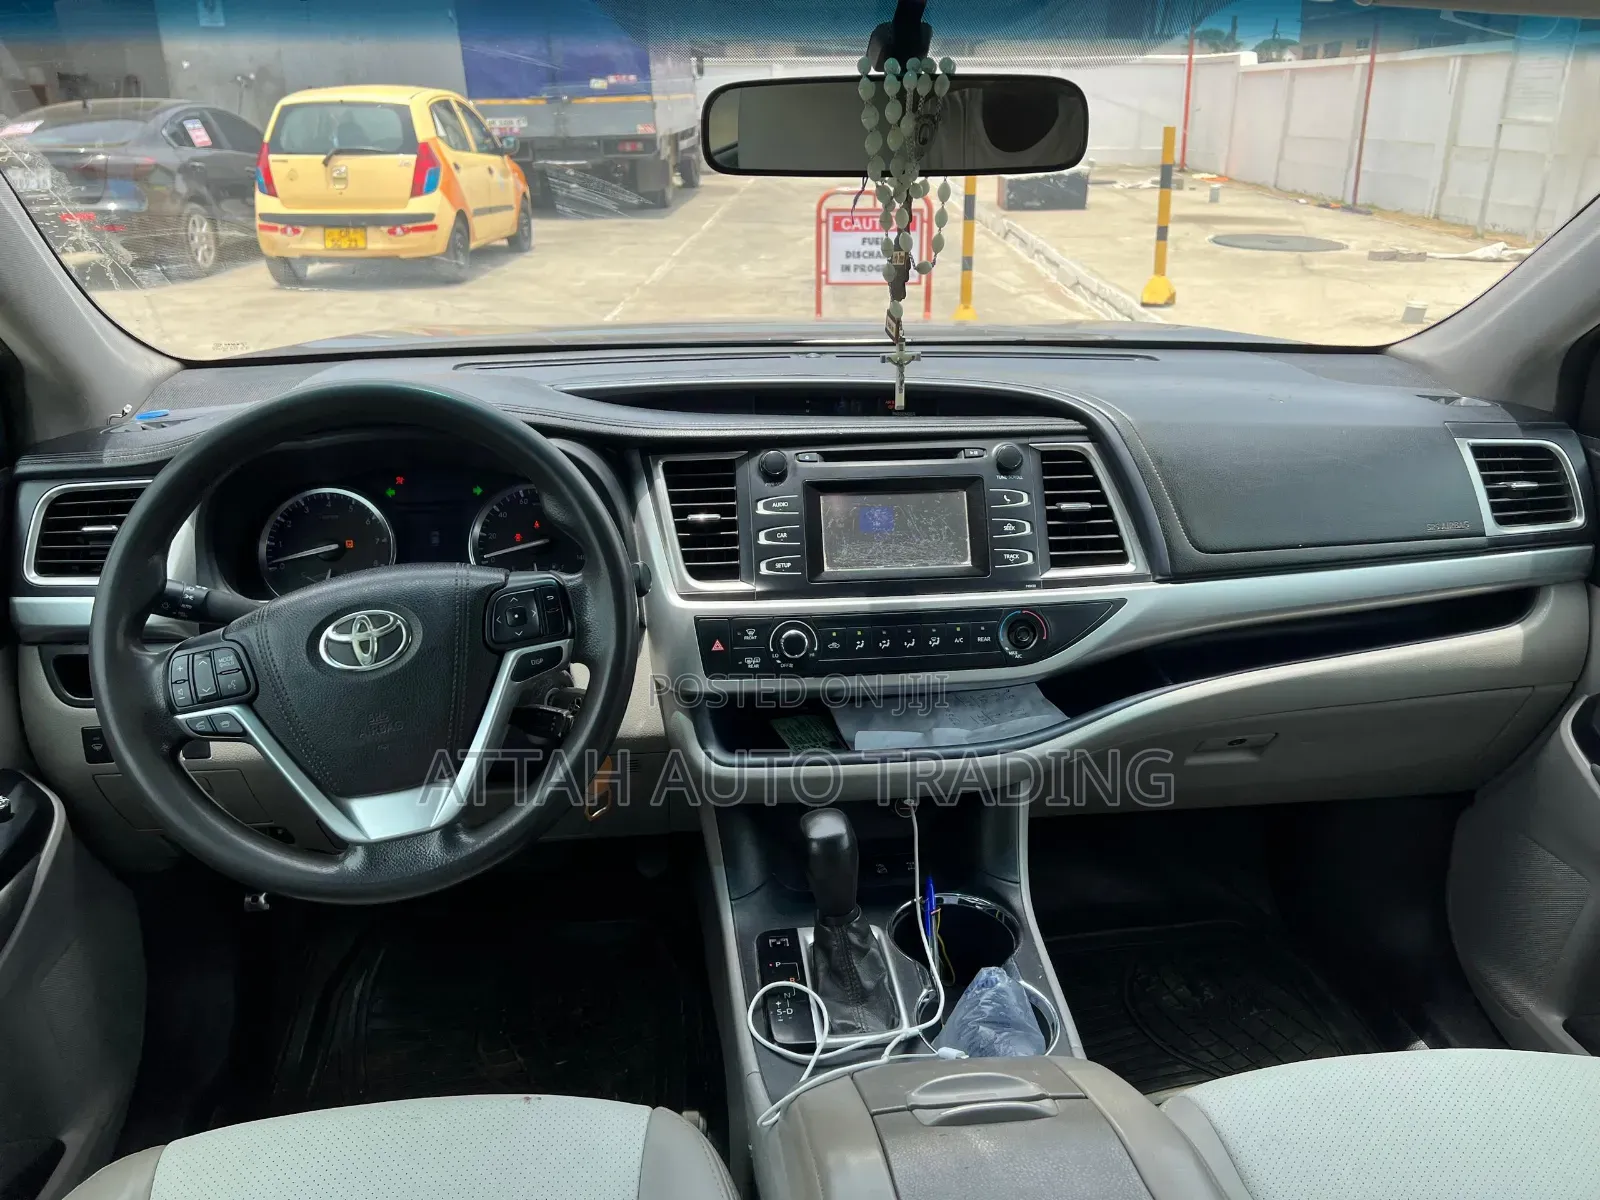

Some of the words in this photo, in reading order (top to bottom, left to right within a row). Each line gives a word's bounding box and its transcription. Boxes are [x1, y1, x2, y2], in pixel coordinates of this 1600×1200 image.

[861, 237, 885, 245] FUE
[845, 251, 888, 259] DISCHA
[841, 264, 851, 273] IN
